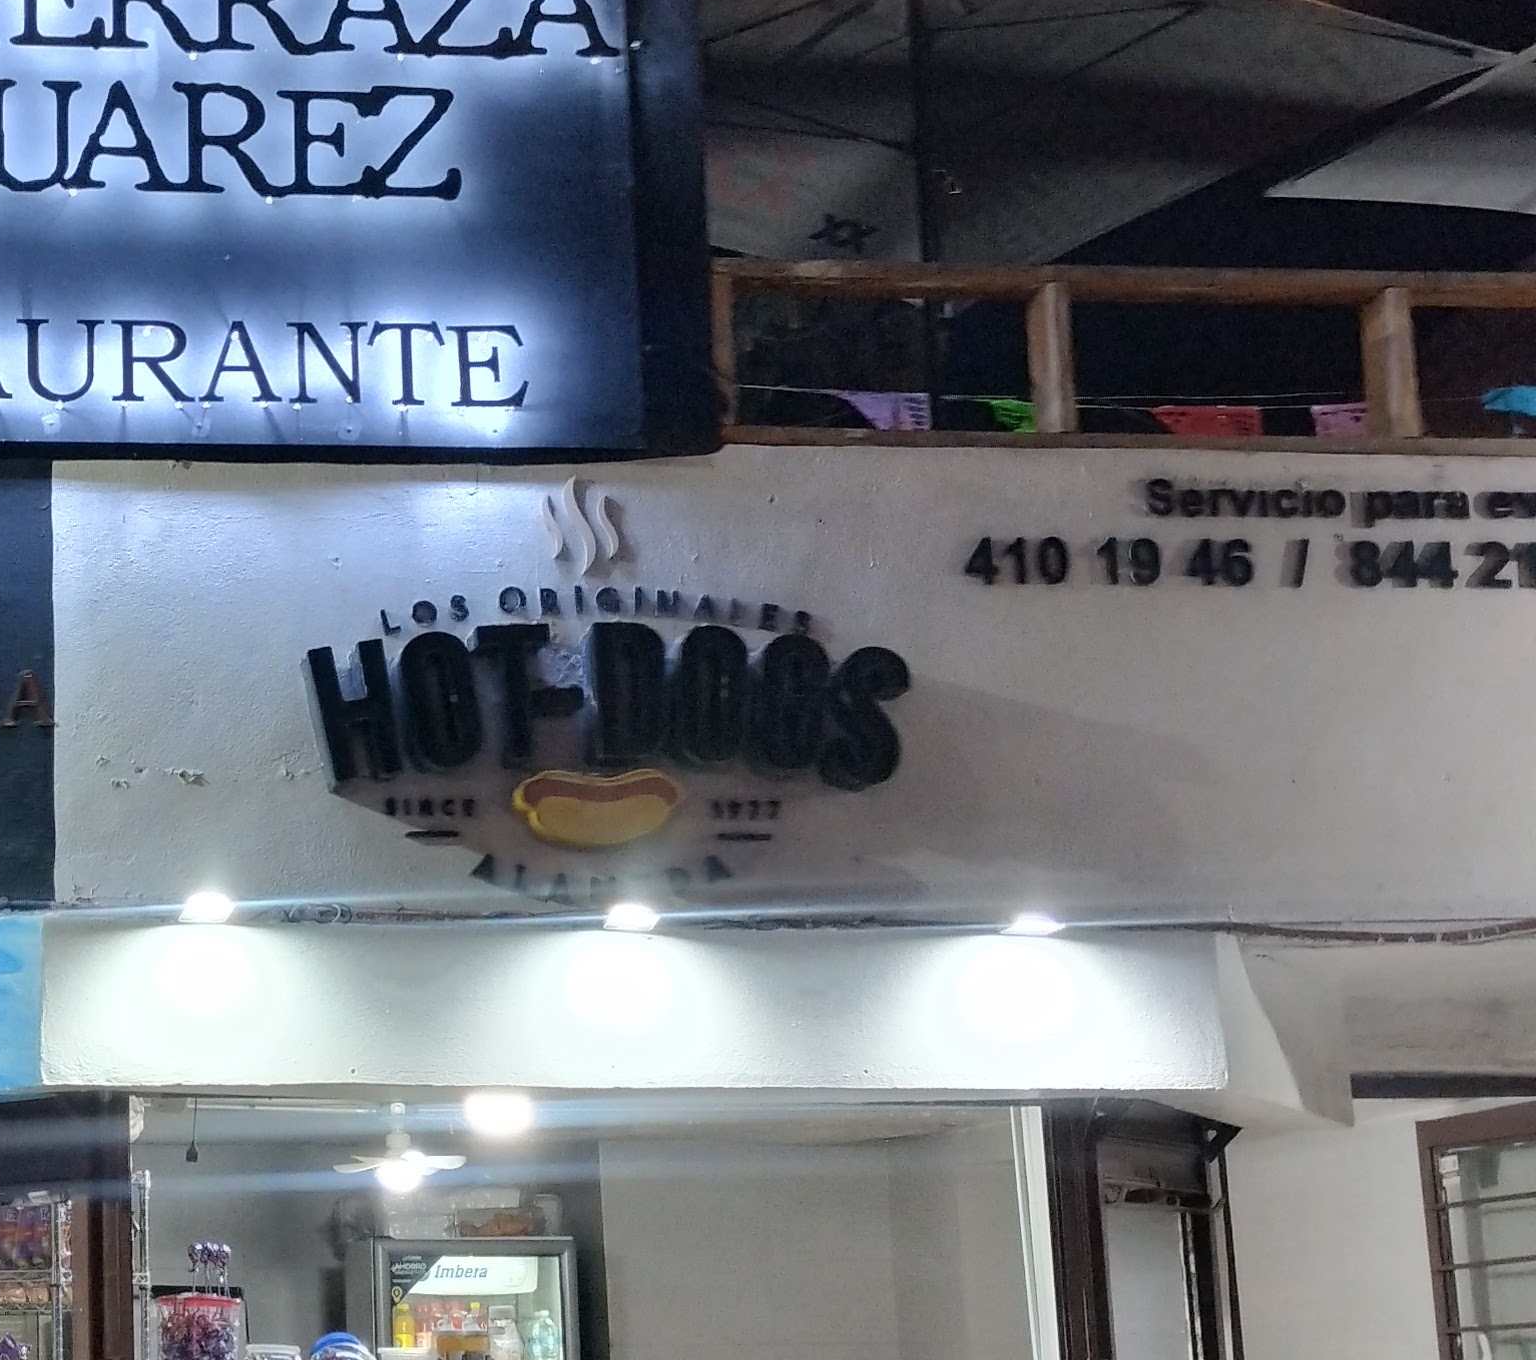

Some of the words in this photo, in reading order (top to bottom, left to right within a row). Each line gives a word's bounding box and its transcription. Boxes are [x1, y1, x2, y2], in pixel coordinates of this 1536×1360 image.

[1144, 478, 1346, 518] Servicio
[1350, 490, 1470, 528] para
[964, 535, 1070, 586] 410
[1096, 537, 1162, 587] 19
[1186, 538, 1255, 587] 46
[1334, 541, 1460, 589] 844
[380, 594, 470, 636] LOS
[434, 1264, 489, 1279] Imbera
